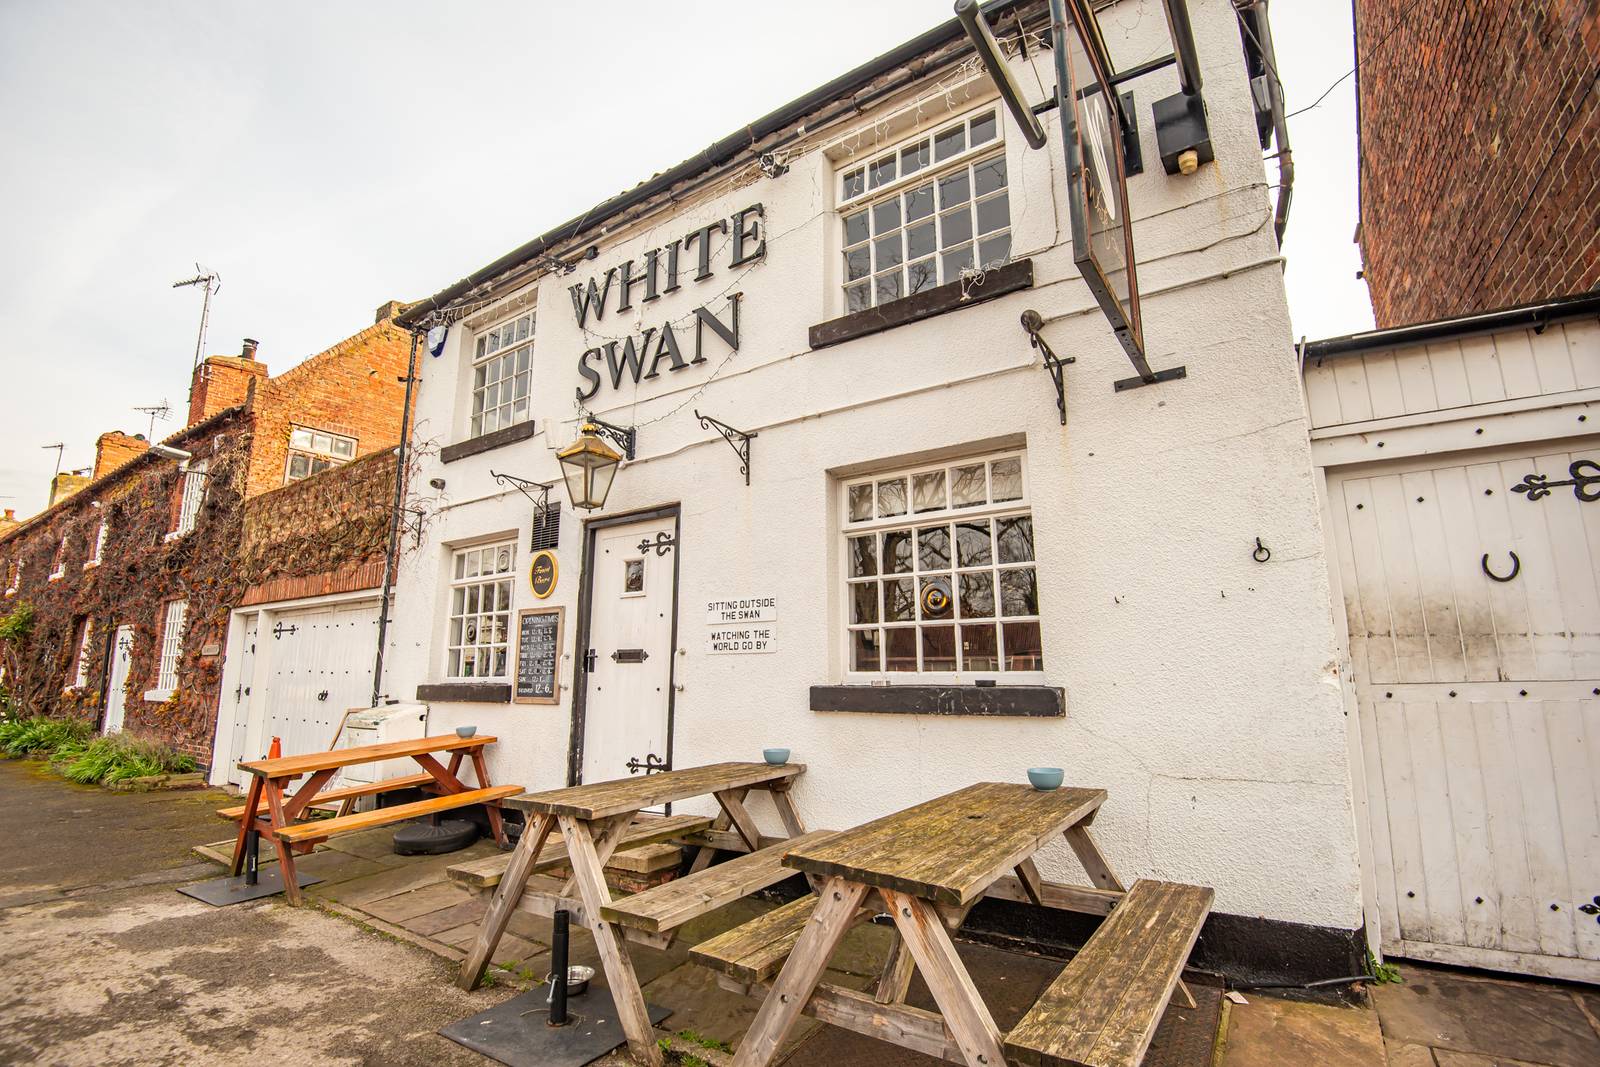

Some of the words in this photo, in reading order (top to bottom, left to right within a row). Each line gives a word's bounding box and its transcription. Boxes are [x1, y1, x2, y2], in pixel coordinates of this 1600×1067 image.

[567, 202, 767, 329] WHITE
[575, 291, 744, 401] SWAN
[707, 600, 738, 611] SITTING
[739, 598, 775, 609] OUTSIDE
[721, 611, 737, 620] THE
[738, 610, 760, 619] SWAN
[711, 630, 750, 641] WATCHING
[753, 629, 770, 639] THE
[713, 641, 739, 651] WORLD
[742, 641, 753, 650] GO
[756, 640, 767, 650] BY
